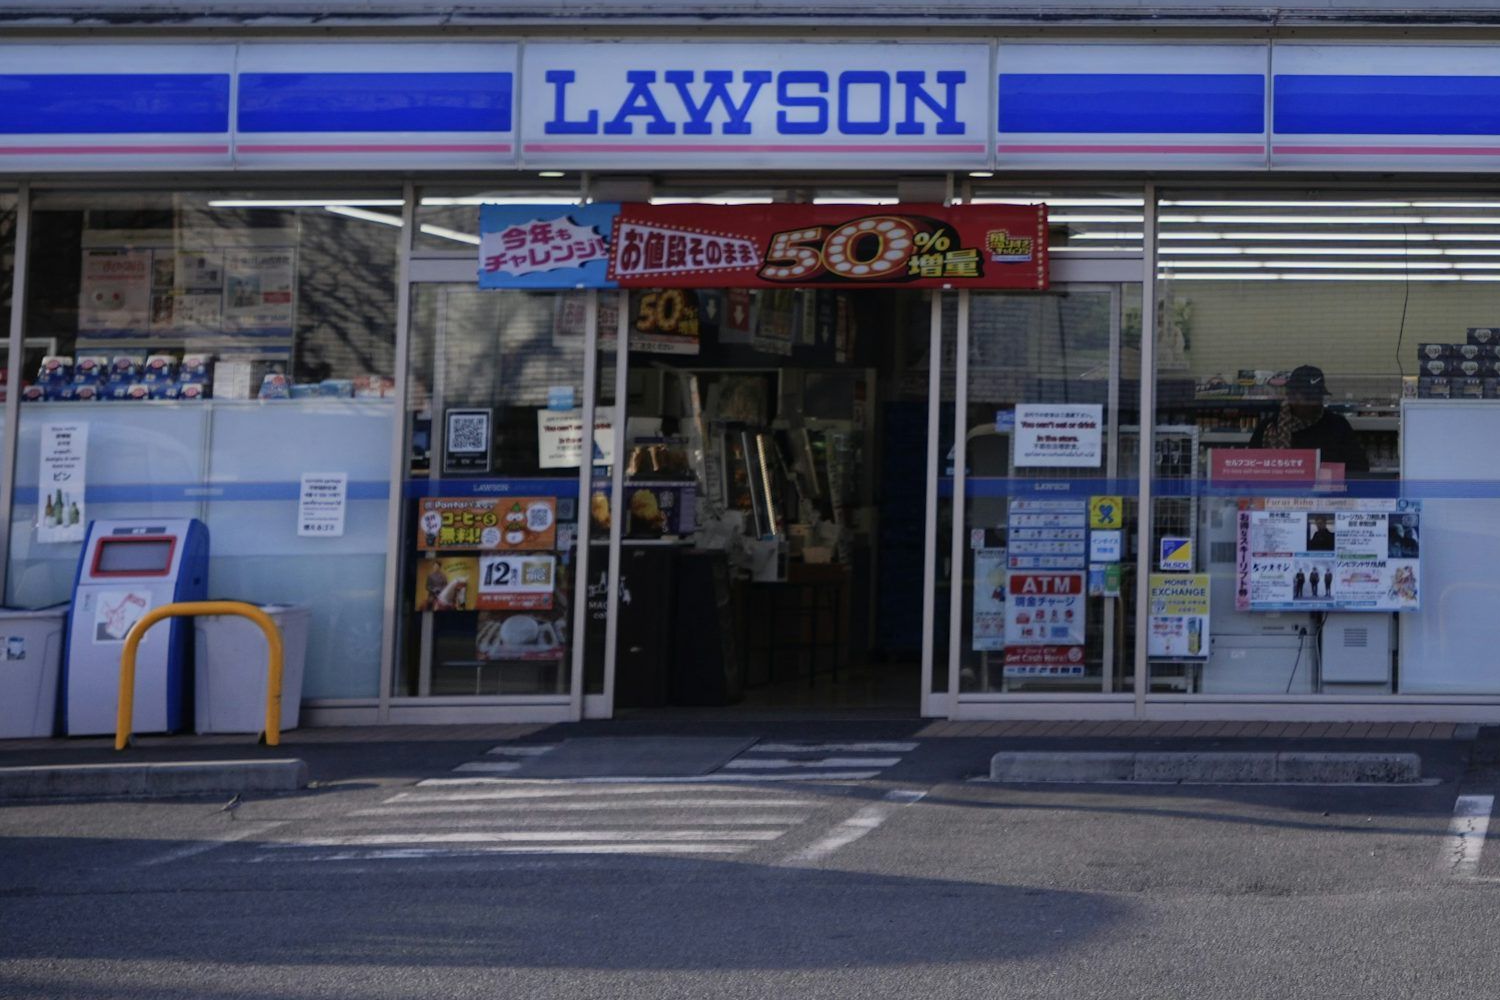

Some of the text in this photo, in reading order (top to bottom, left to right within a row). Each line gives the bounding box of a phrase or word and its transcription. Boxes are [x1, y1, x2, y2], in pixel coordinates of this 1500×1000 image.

[545, 70, 966, 134] LAWSON
[502, 223, 572, 250] 今年も
[758, 214, 950, 280] 50%
[620, 228, 756, 270] お値段そのまま
[908, 248, 981, 277] 増量
[53, 472, 71, 481] ビン
[473, 484, 509, 492] LAWSON
[1022, 576, 1071, 594] ATM
[1152, 588, 1206, 597] EXCHANGE
[1164, 579, 1194, 587] MONEY
